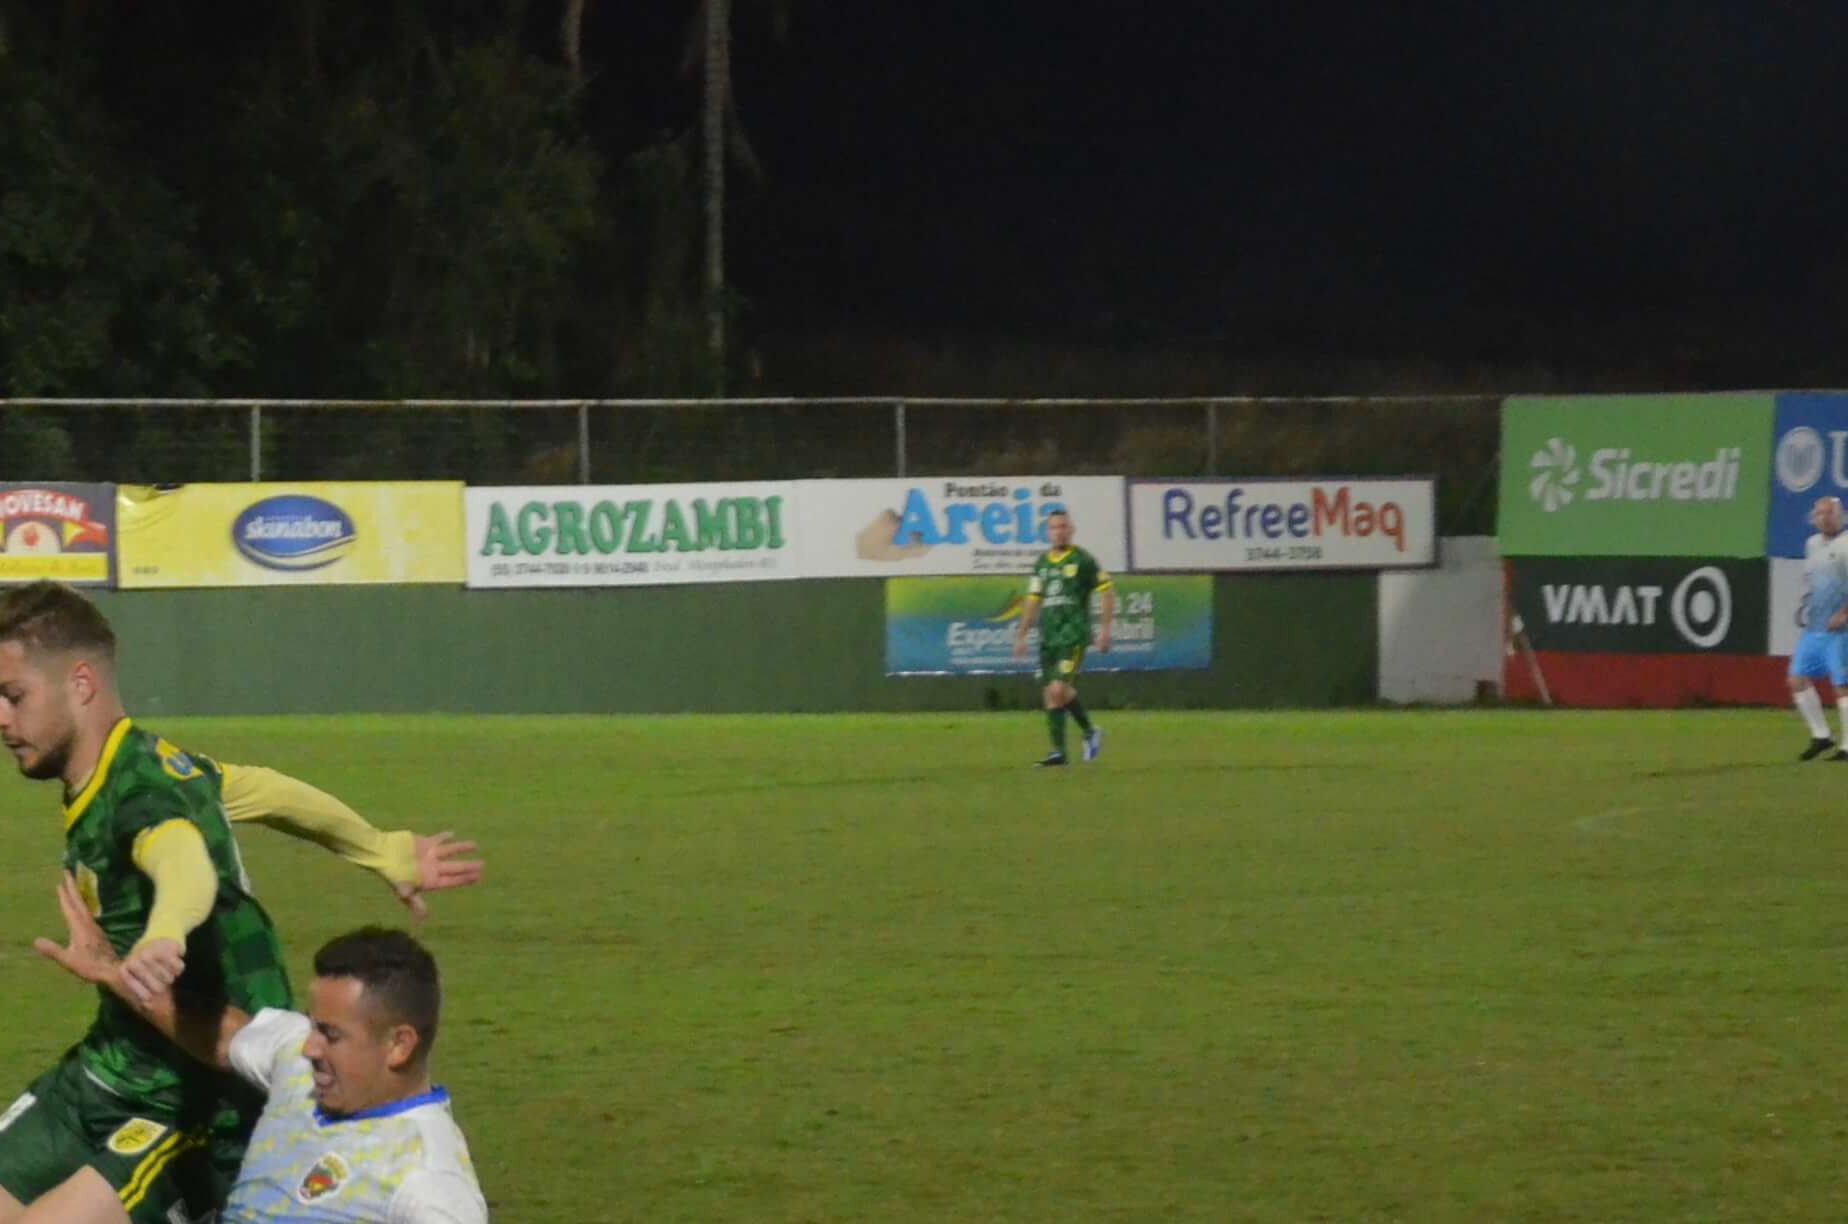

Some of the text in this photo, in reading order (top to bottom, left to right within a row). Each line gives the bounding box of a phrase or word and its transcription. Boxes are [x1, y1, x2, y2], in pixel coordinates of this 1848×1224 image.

[944, 482, 1063, 498] Pontão da
[1585, 448, 1741, 501] Sicredi
[480, 495, 786, 556] AGROZAMBI
[1163, 487, 1405, 551] RefreeMaq
[1541, 584, 1662, 625] VMAT
